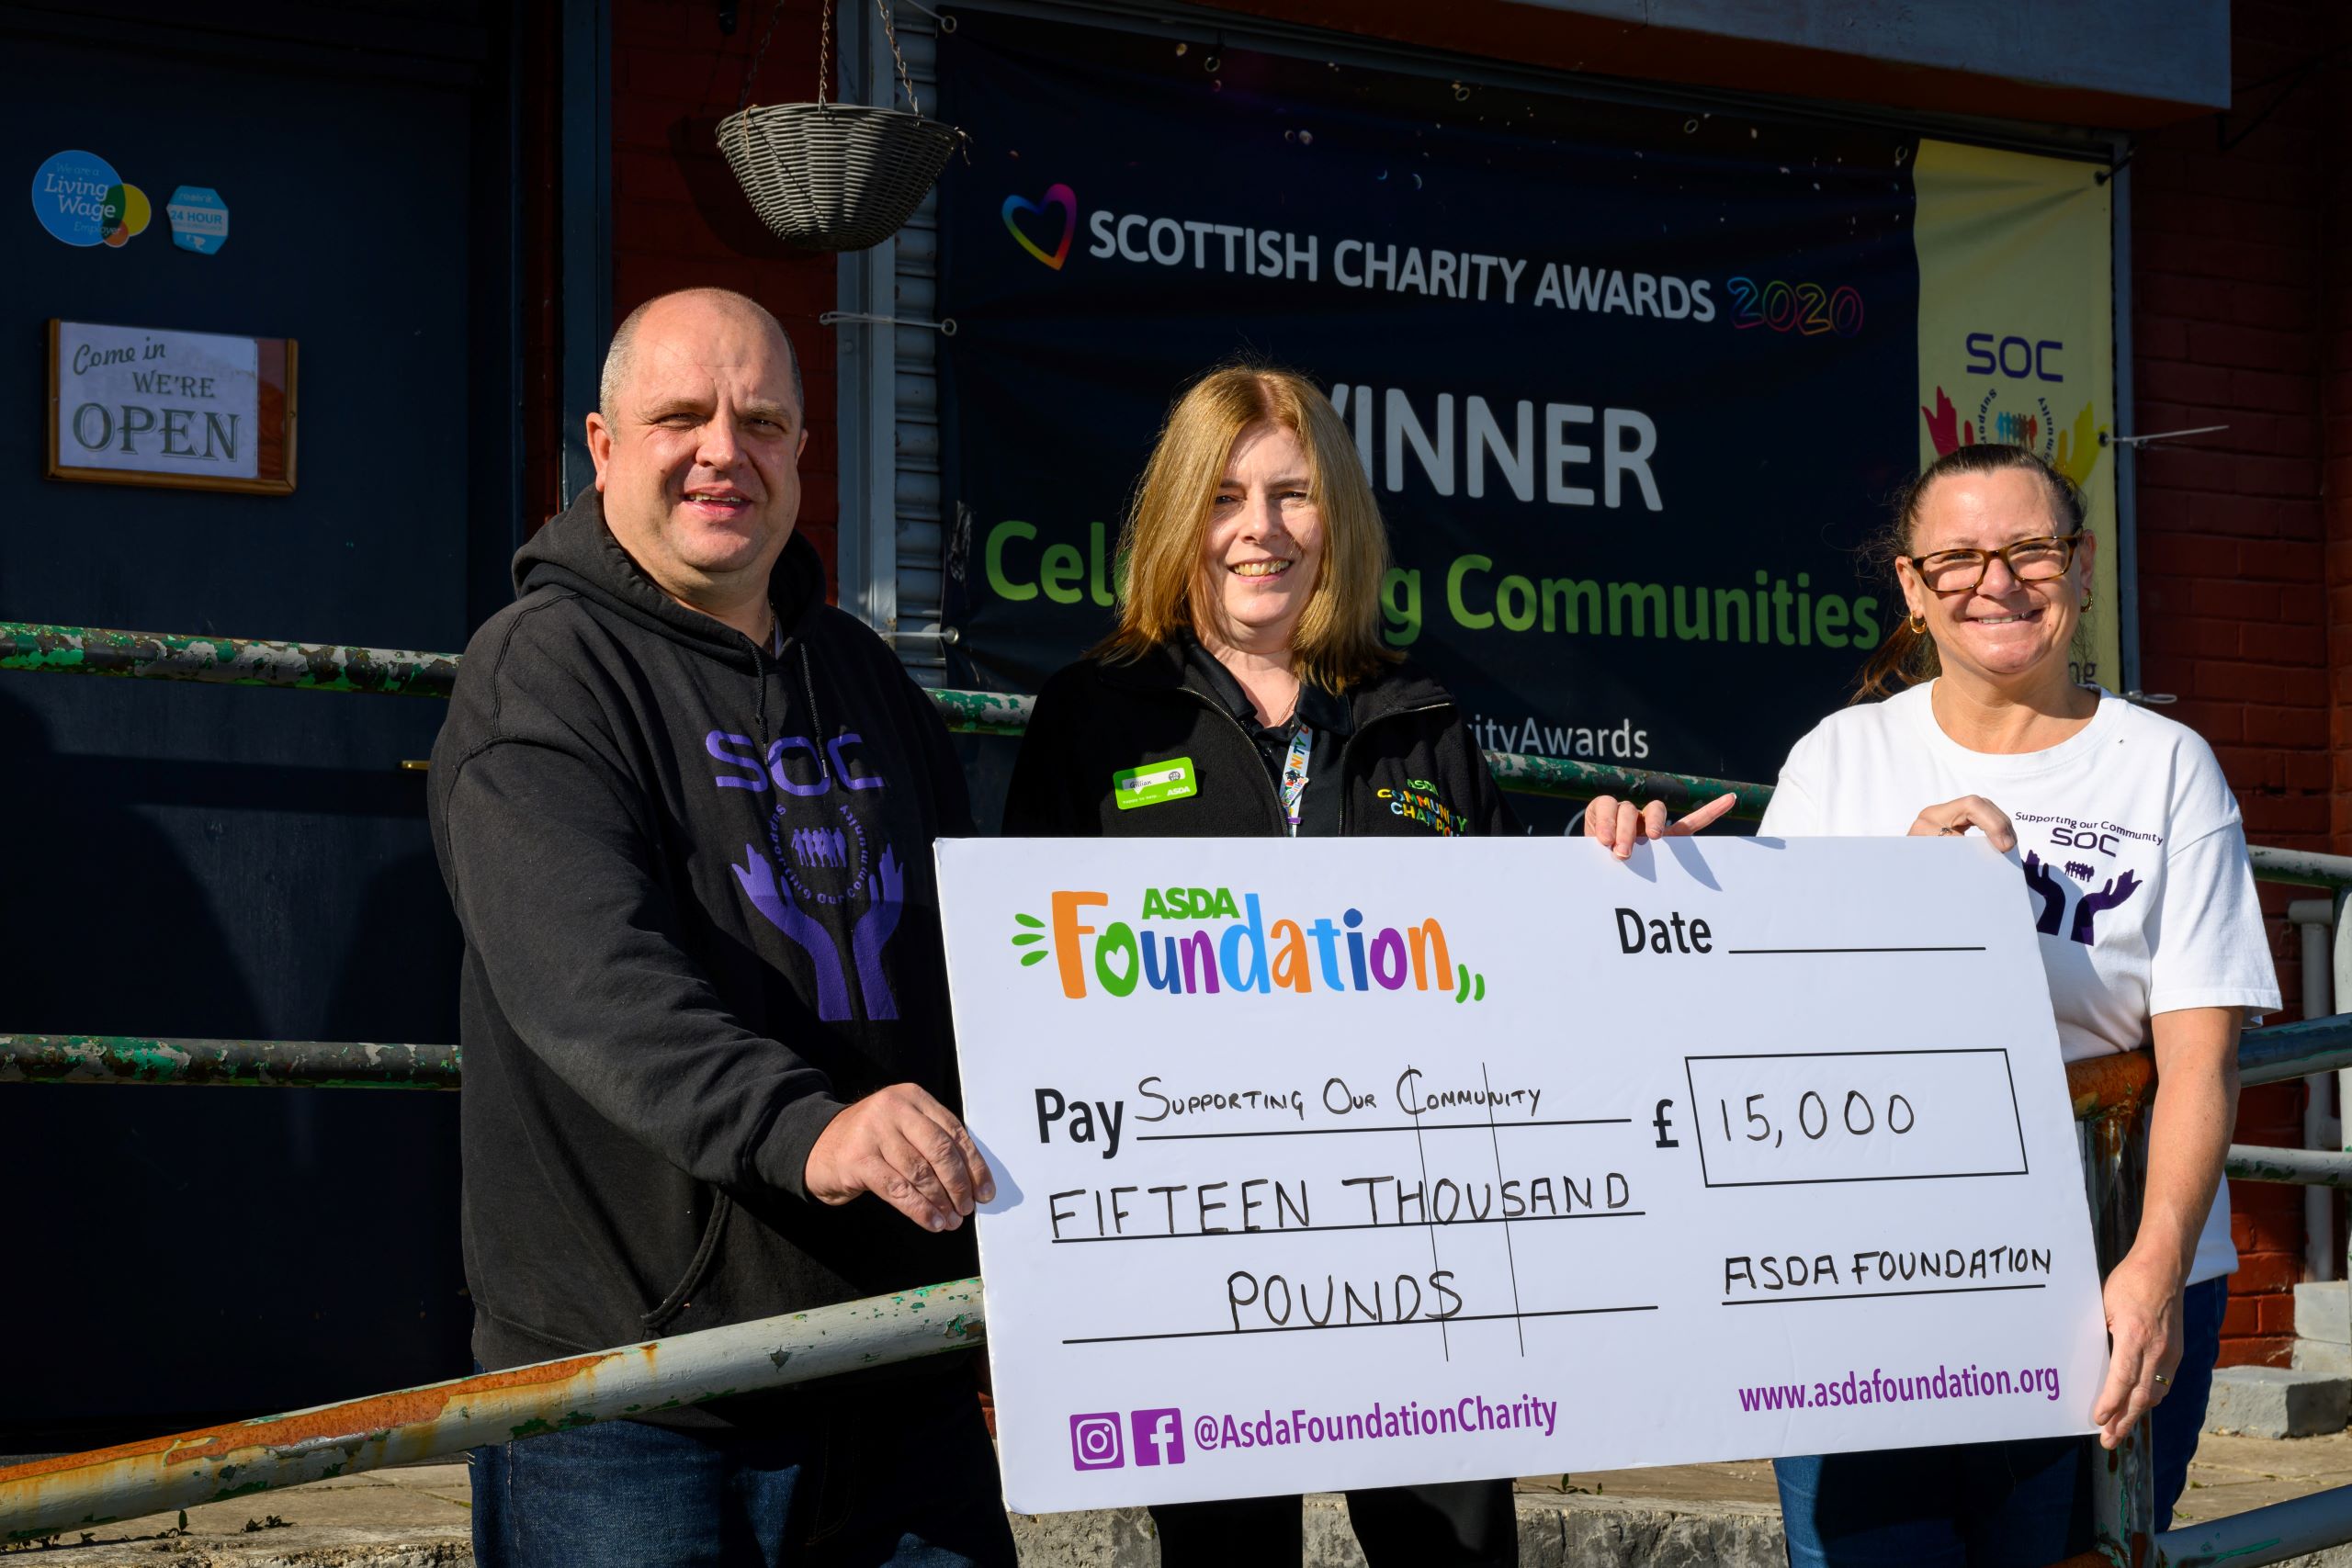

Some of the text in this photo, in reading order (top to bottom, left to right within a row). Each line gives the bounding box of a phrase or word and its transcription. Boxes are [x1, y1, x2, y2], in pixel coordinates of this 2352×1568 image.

[44, 173, 109, 202] Living
[57, 195, 117, 222] Wage
[74, 220, 121, 239] Employer
[171, 210, 222, 224] 24 HOUR
[1089, 209, 1865, 339] SCOTTISH CHARITY AWARDS 2020
[72, 336, 167, 376] Come in
[1965, 332, 2064, 383] SOC
[132, 370, 217, 400] WE'RE
[72, 401, 241, 463] OPEN
[1330, 383, 1664, 512] INNER
[1446, 553, 1881, 650] Communities
[705, 729, 886, 797] SOC
[1166, 785, 1191, 796] ASDA
[1376, 787, 1468, 833] COMMUNITY
[2015, 811, 2164, 846] Supporting our Community
[2050, 827, 2120, 858] SOC
[1141, 886, 1241, 920] ASDA
[1051, 890, 1455, 999] Foundation
[1614, 907, 1713, 955] Date
[1035, 1088, 1125, 1160] Pay
[1652, 1099, 1679, 1148] £
[1721, 1089, 1915, 1148] 15,000
[1048, 1172, 1630, 1238] FIFTEEN THOUSAND
[1725, 1245, 2052, 1295] ASDA FOUNDATION
[1227, 1270, 1464, 1331] POUNDS
[1738, 1363, 2062, 1413] www.asdafoundation.org
[1193, 1393, 1558, 1451] @AsdaFoundationCharity
